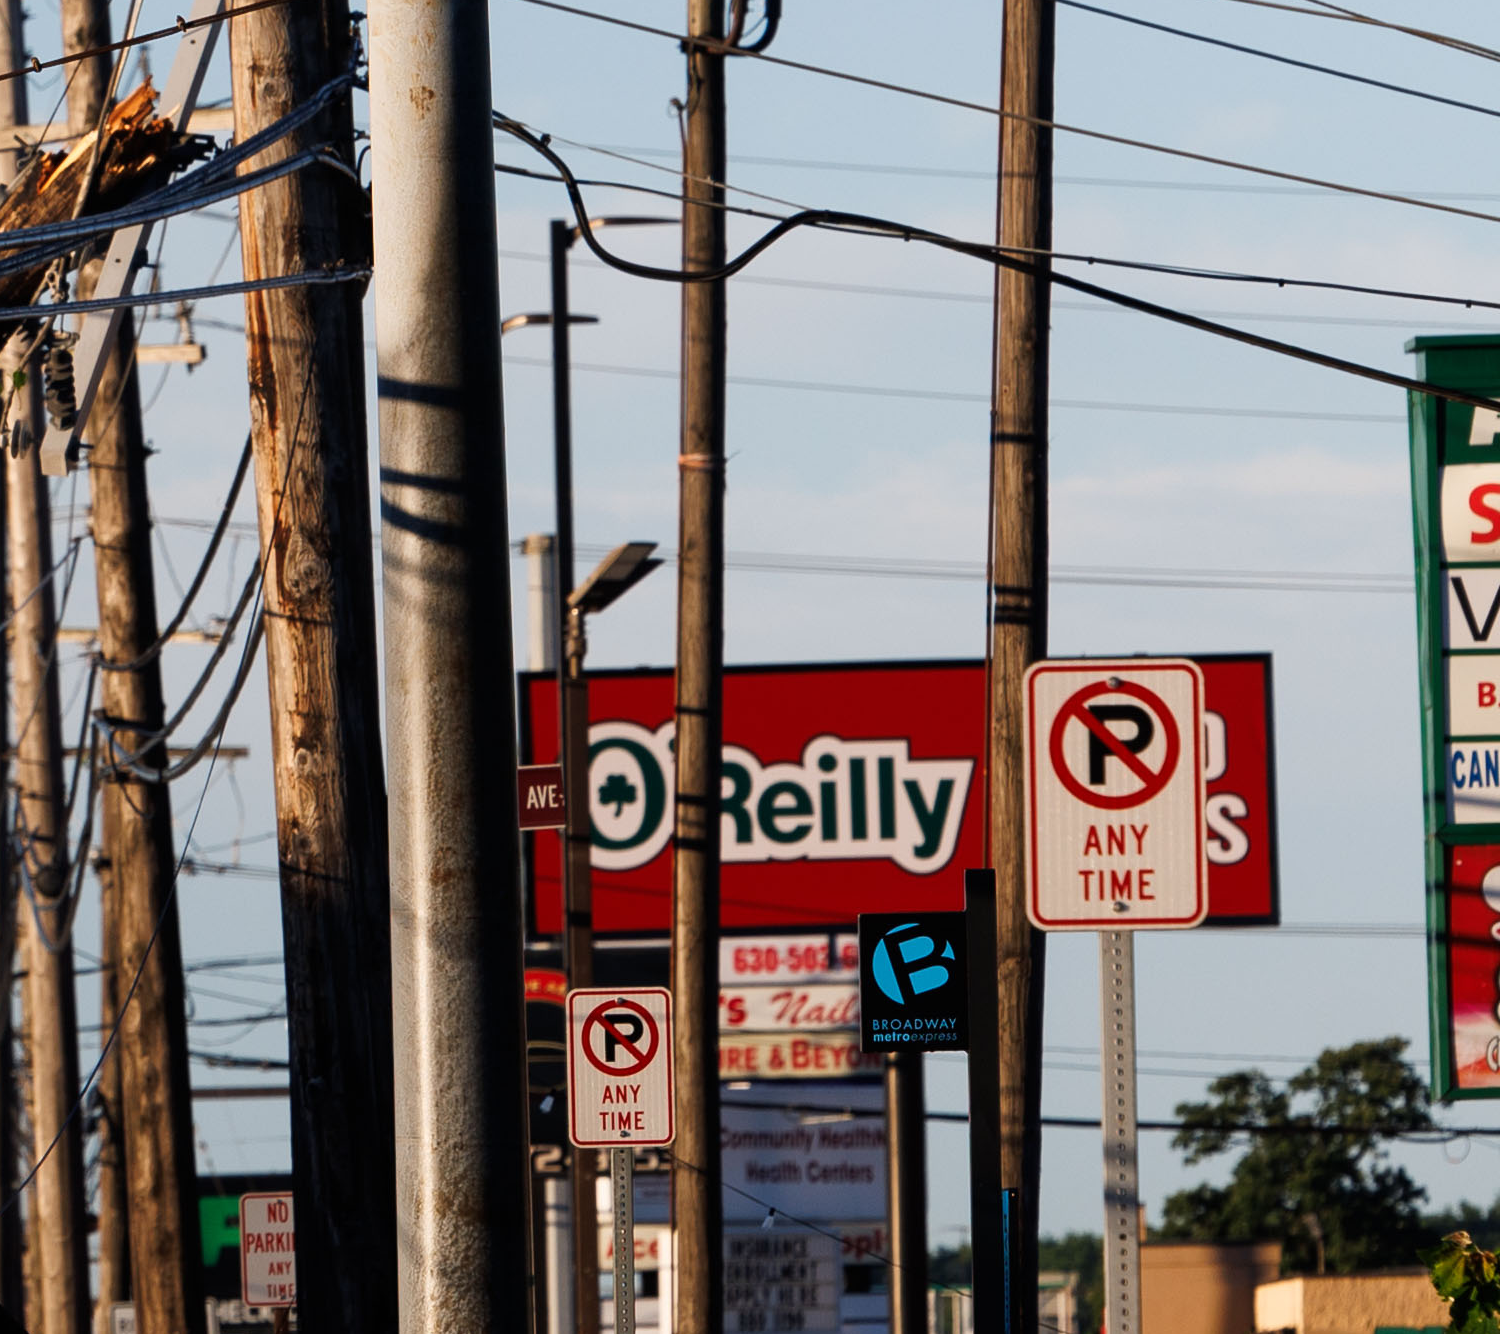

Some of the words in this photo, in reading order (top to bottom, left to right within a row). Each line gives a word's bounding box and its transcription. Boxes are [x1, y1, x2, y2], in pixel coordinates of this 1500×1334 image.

[526, 784, 559, 809] AVE
[1084, 824, 1149, 856] ANY
[1078, 869, 1155, 901] TIME
[873, 1018, 957, 1030] BROADWAY
[602, 1084, 641, 1105] ANY
[599, 1111, 646, 1131] TIME
[746, 1160, 802, 1182] Health
[807, 1160, 875, 1184] Centers
[267, 1202, 289, 1223] NO
[268, 1262, 293, 1276] ANY
[266, 1283, 296, 1299] TIME
